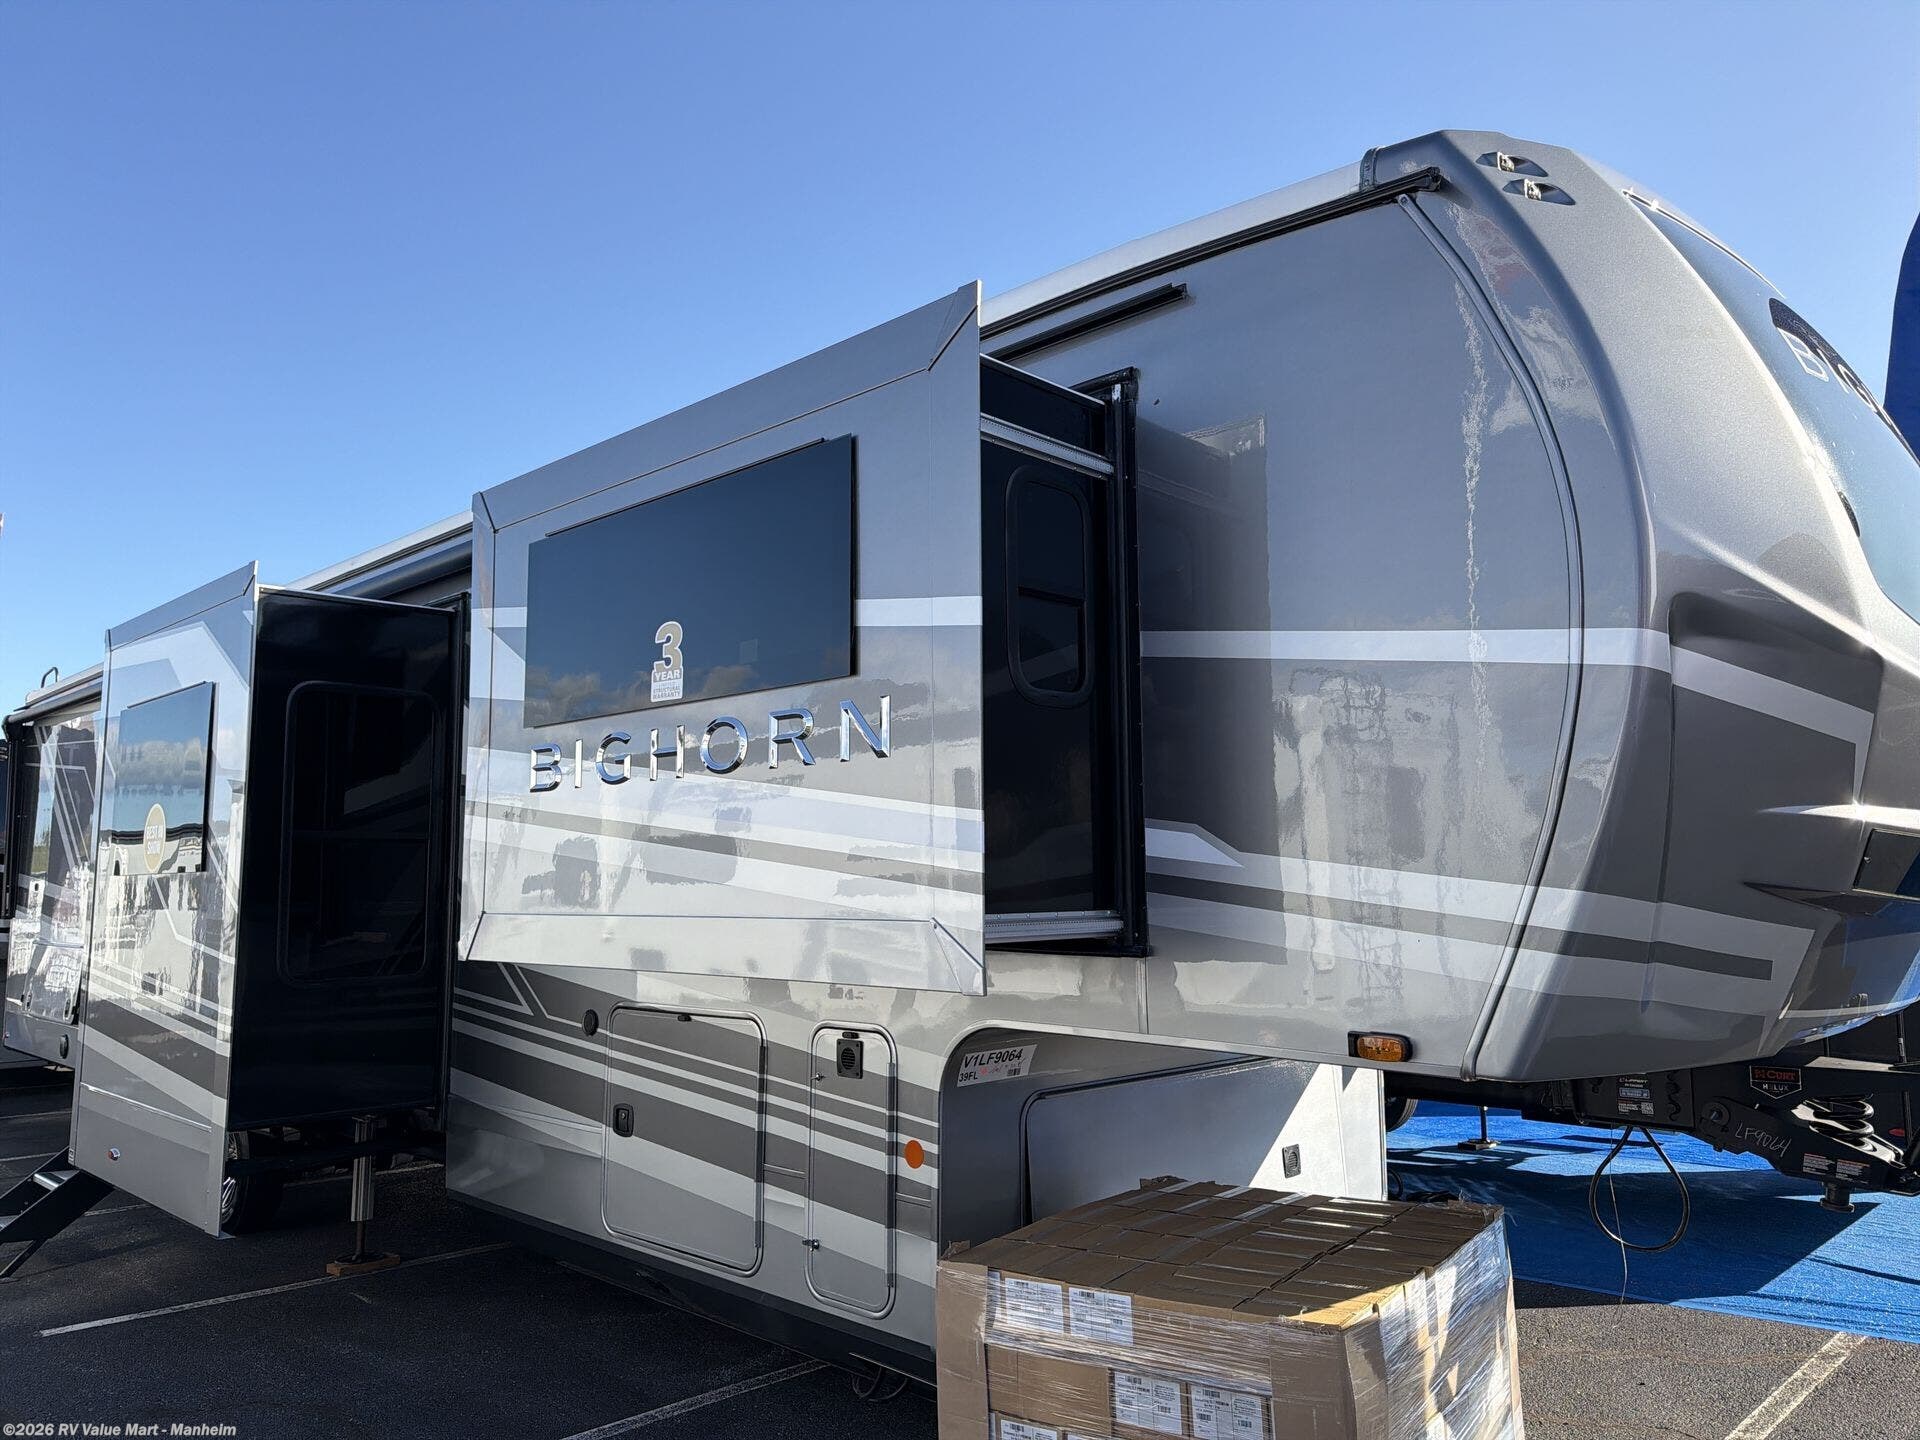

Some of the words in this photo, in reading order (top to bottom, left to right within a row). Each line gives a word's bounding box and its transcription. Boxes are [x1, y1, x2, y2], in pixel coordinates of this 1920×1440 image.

[654, 621, 683, 671] 3
[654, 669, 681, 681] YEAR
[529, 694, 892, 793] BIGHORN
[964, 1048, 1023, 1068] V1LF9064
[959, 1071, 978, 1082] 39FL
[1735, 1120, 1791, 1157] LF9064
